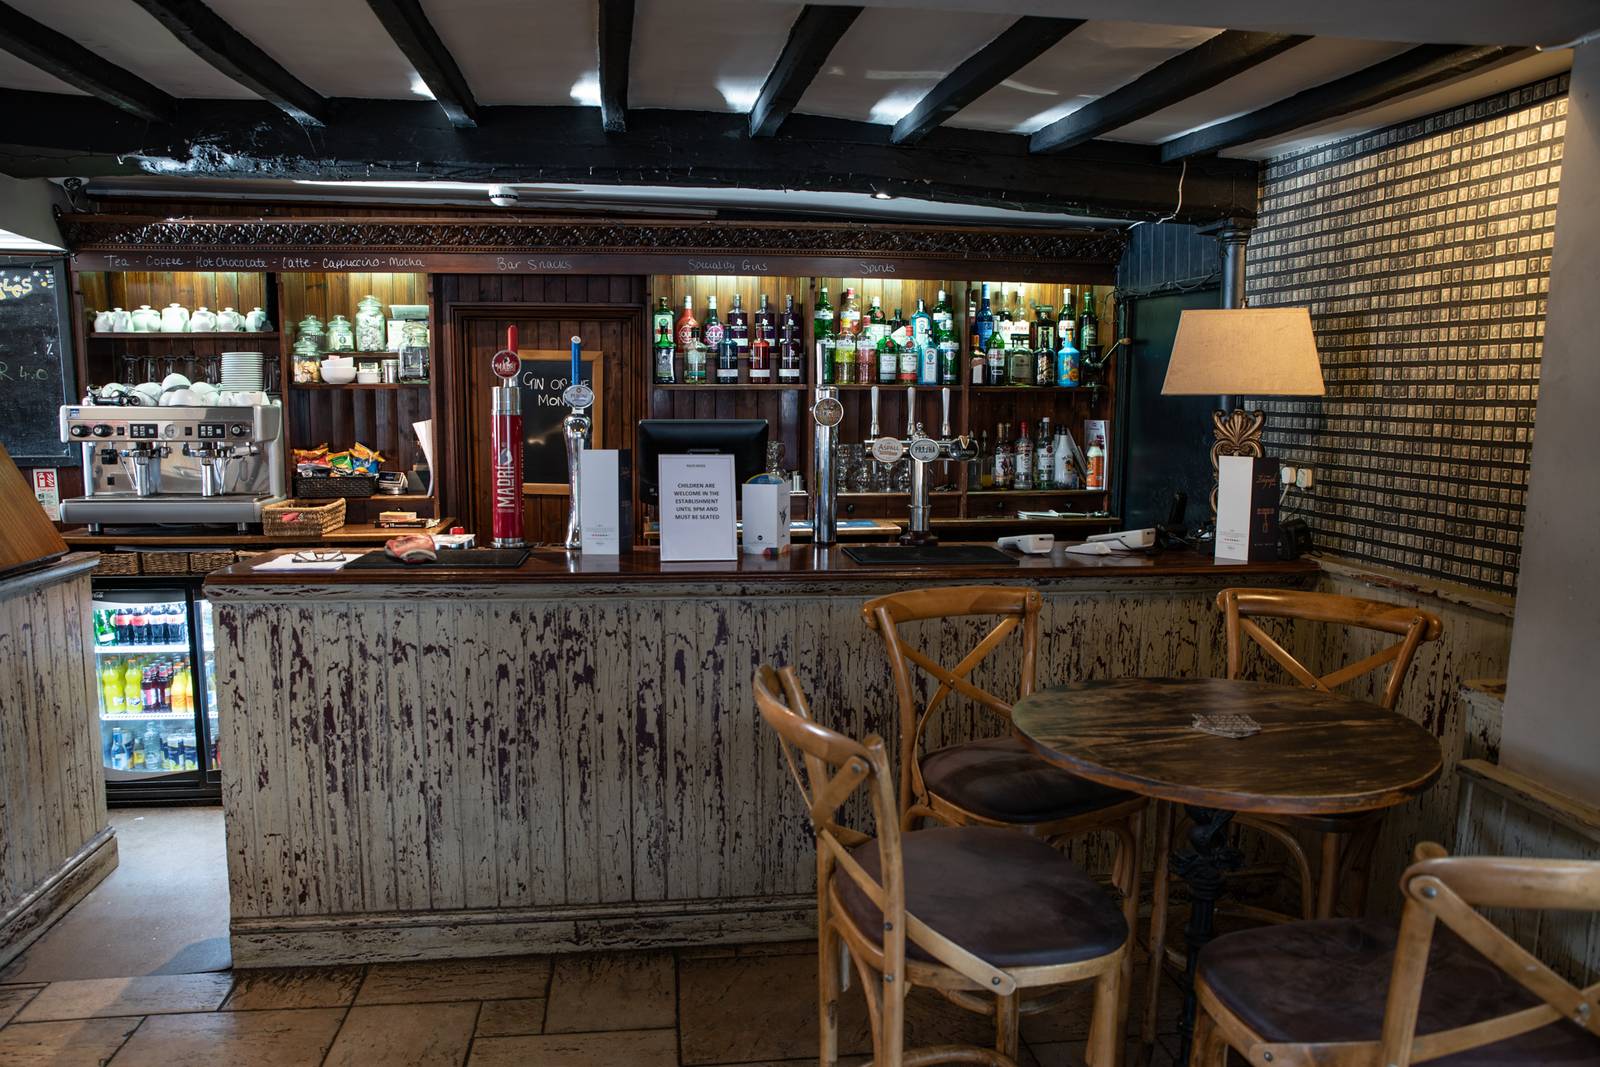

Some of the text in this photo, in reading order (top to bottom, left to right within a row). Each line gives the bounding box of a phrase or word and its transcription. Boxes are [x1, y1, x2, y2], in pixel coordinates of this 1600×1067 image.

[104, 254, 130, 268] Tea
[145, 255, 184, 268] Coffee
[389, 256, 425, 268] Mocha
[497, 257, 573, 271] Bar Snacks
[523, 371, 545, 390] GIN
